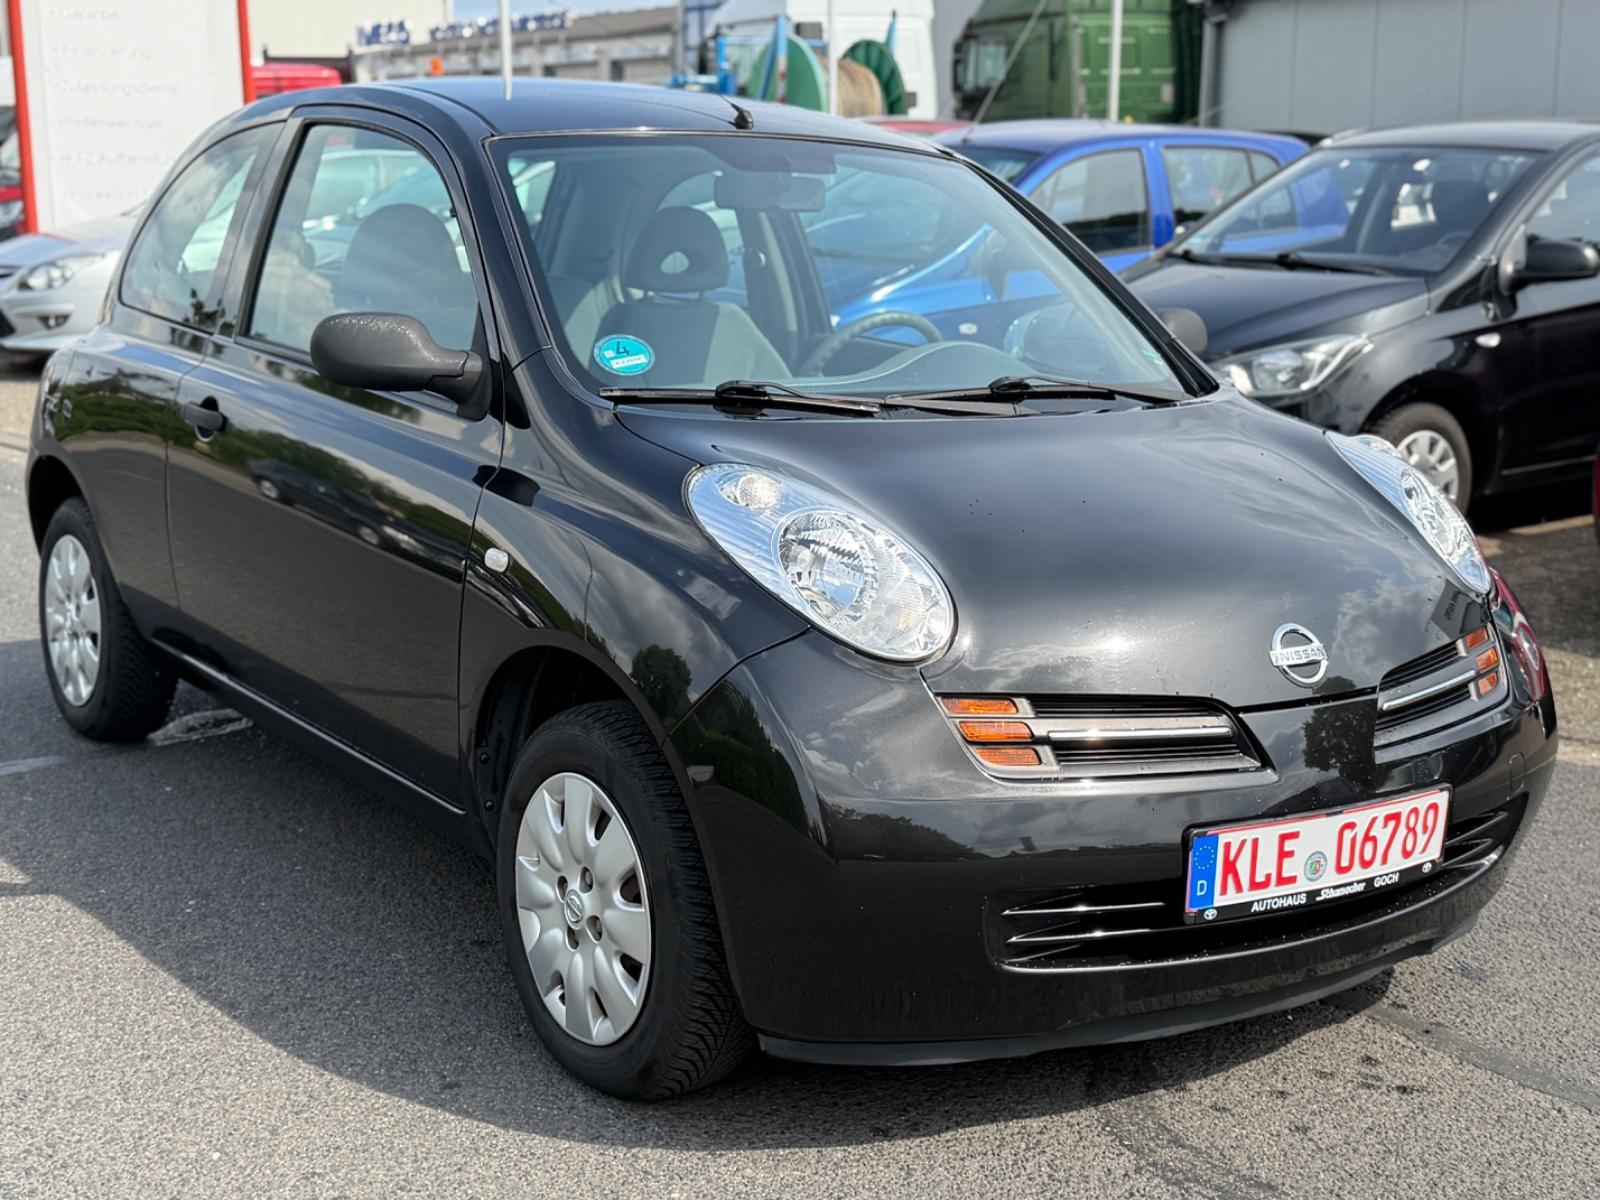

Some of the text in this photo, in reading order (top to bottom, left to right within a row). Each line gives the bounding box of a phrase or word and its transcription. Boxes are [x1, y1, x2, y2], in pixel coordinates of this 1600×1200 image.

[616, 341, 629, 355] 4
[1280, 647, 1324, 662] NISSAN
[1219, 831, 1300, 896] KLE
[1334, 802, 1439, 875] 06789
[1196, 880, 1208, 896] D
[1251, 893, 1307, 913] AUTOHAUS
[1373, 873, 1399, 888] GOCH
